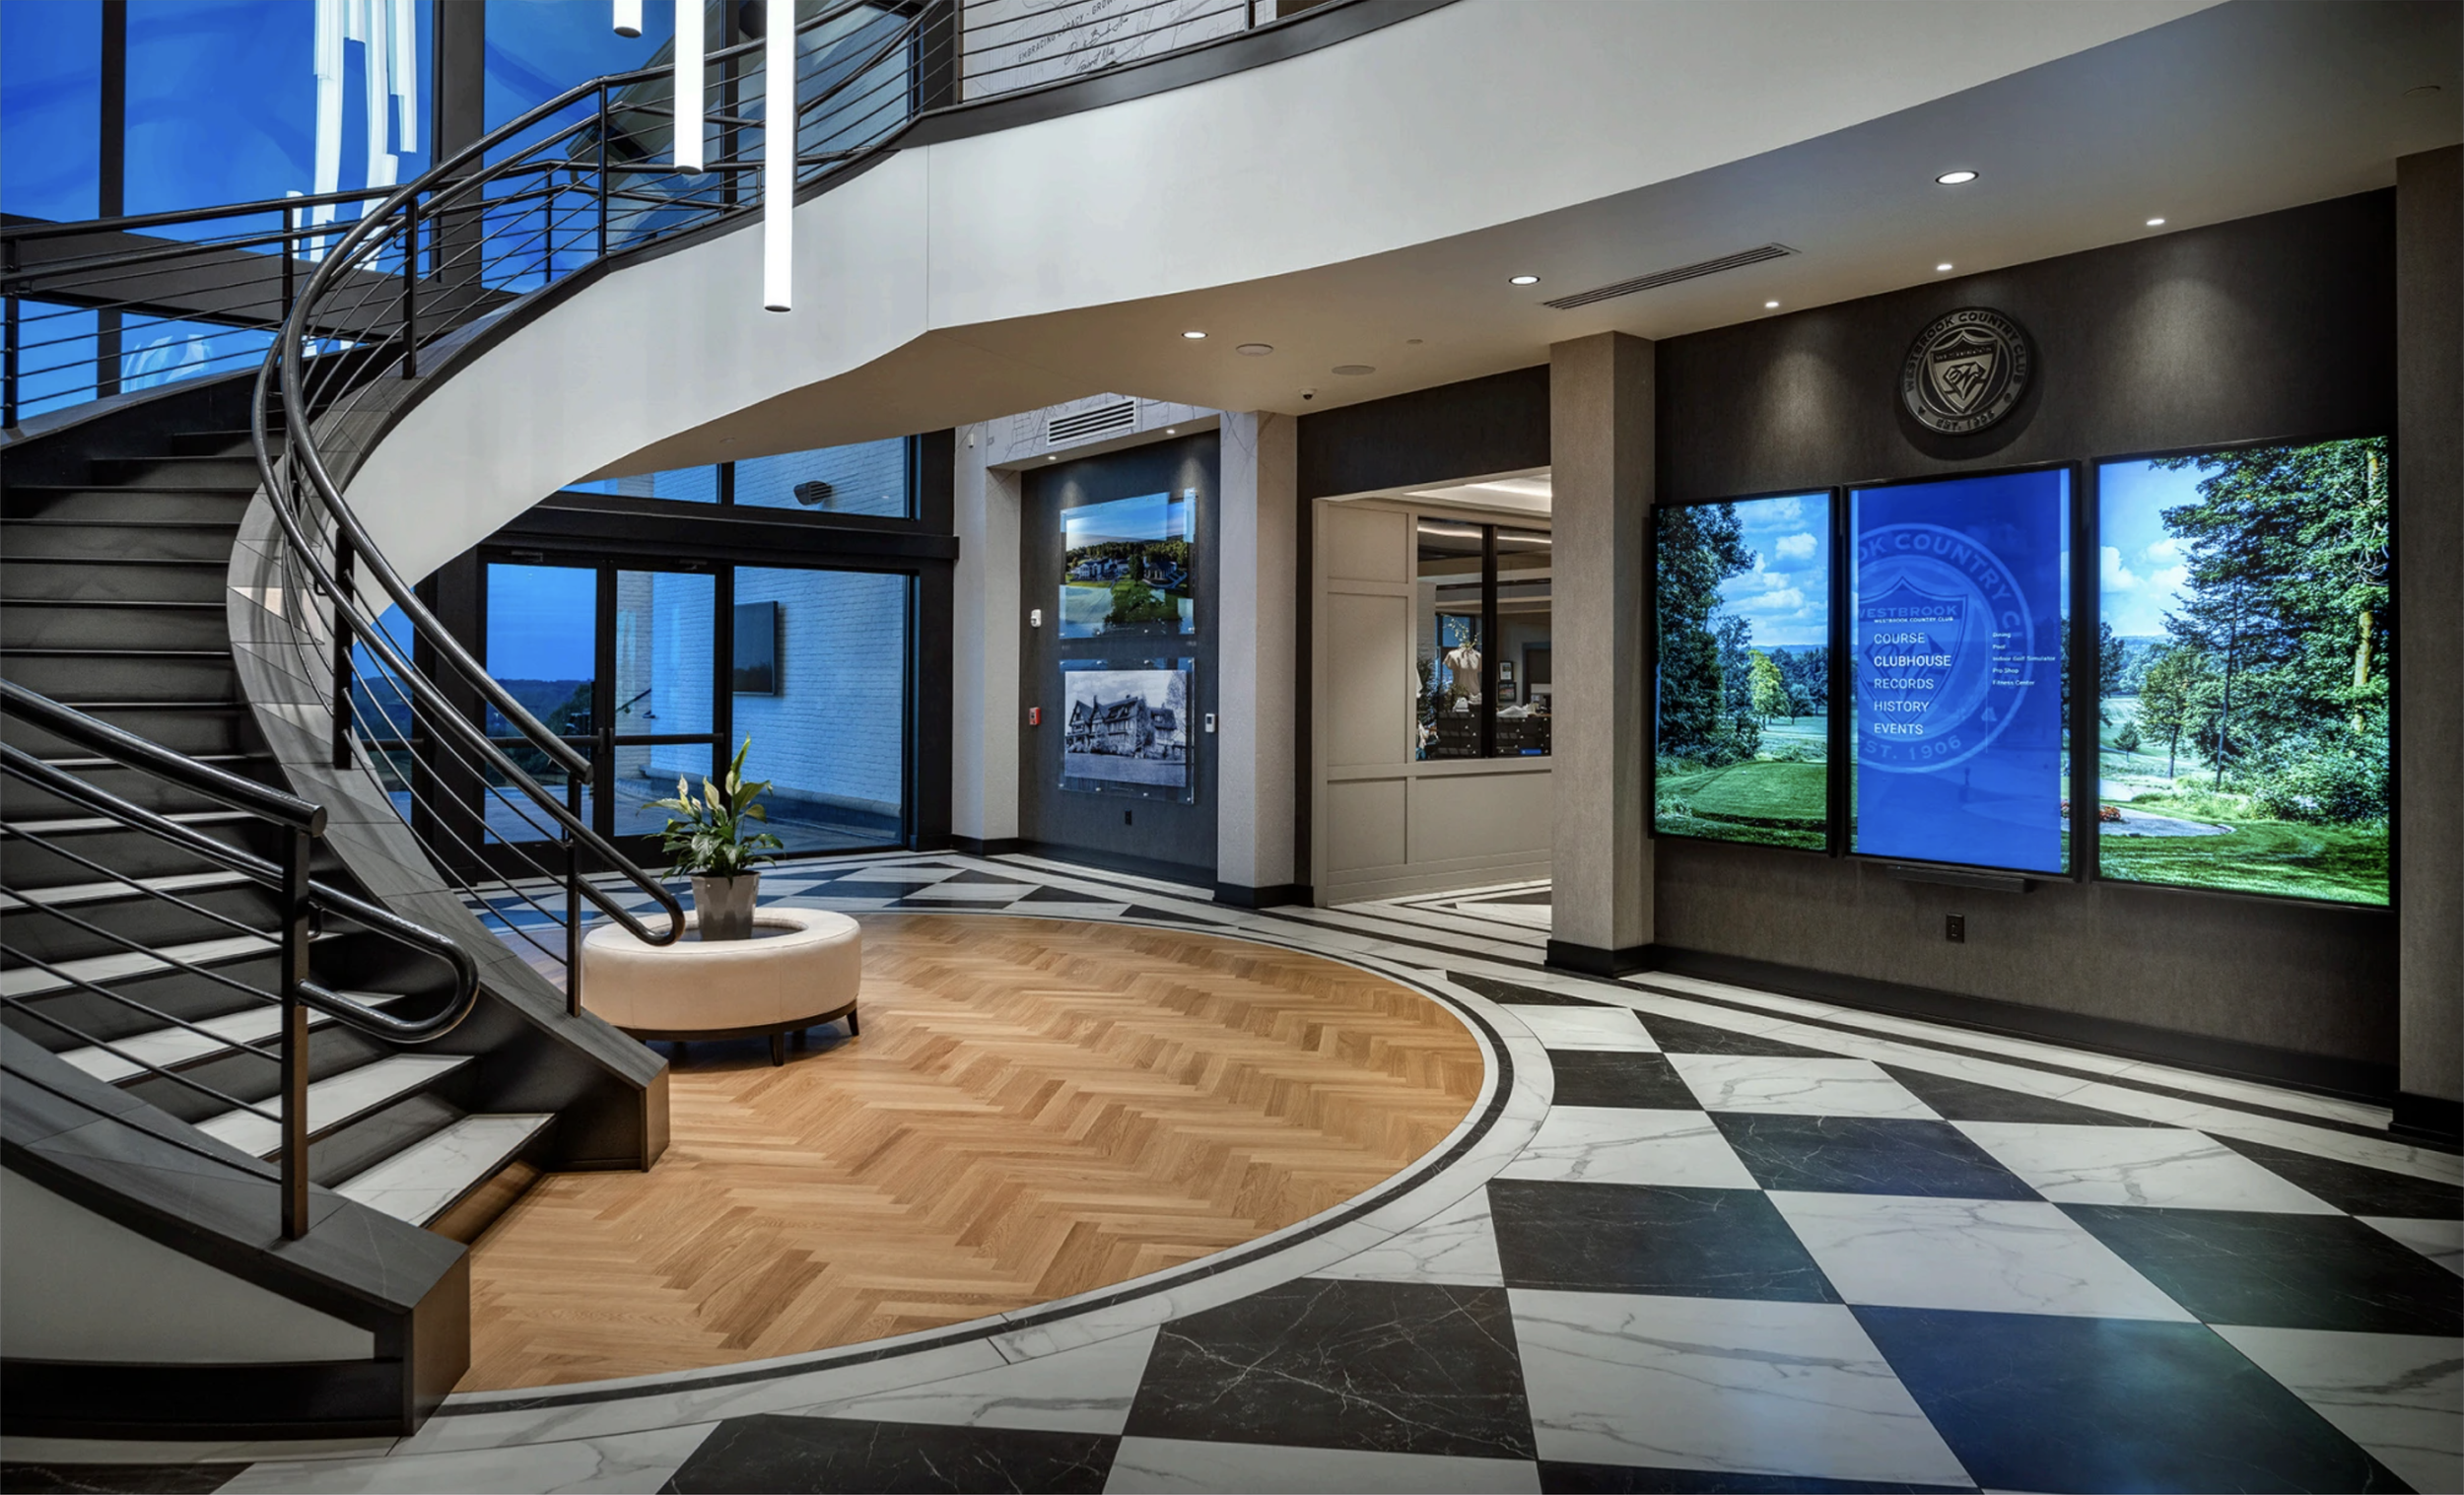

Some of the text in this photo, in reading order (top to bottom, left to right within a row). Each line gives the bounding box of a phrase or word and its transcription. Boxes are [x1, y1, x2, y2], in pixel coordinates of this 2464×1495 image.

[1018, 33, 1057, 62] EMBRACING
[1905, 311, 2026, 392] WESTBROOK COUNTRY CLUB
[1894, 533, 2011, 600] COUNTRY
[1874, 632, 1925, 645] COURSE
[1874, 654, 1951, 667] CLUBHOUSE
[1874, 678, 1935, 690] RECORDS
[1874, 701, 1929, 713] HISTORY
[1874, 722, 1924, 735] EVENTS
[1859, 734, 1961, 761] ST. 1906
